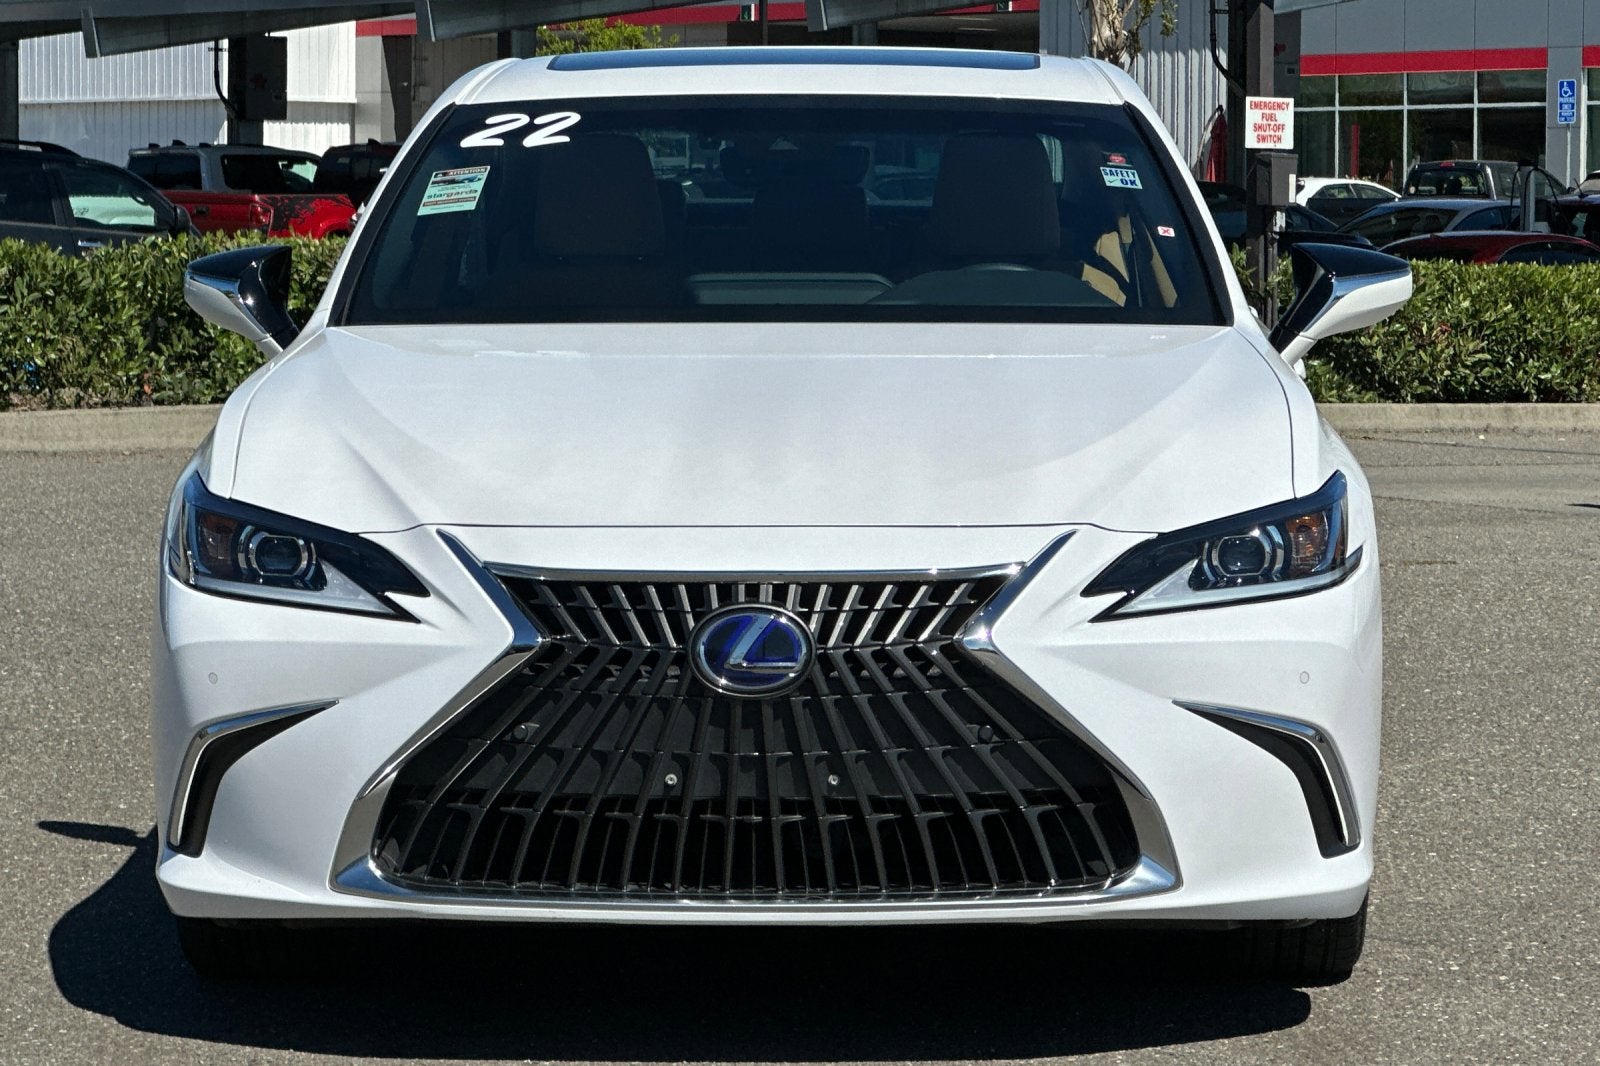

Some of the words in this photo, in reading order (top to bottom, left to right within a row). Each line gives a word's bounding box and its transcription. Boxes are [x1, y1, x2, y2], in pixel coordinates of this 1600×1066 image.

[1249, 100, 1290, 111] EMERGENCY
[1261, 112, 1278, 122] FUEL
[460, 112, 581, 148] 22
[1253, 122, 1286, 133] SHUT-OFF
[1256, 134, 1282, 144] SWITCH
[448, 167, 486, 177] ATTENTION
[1102, 168, 1137, 179] SAFETY
[1120, 178, 1138, 187] OK
